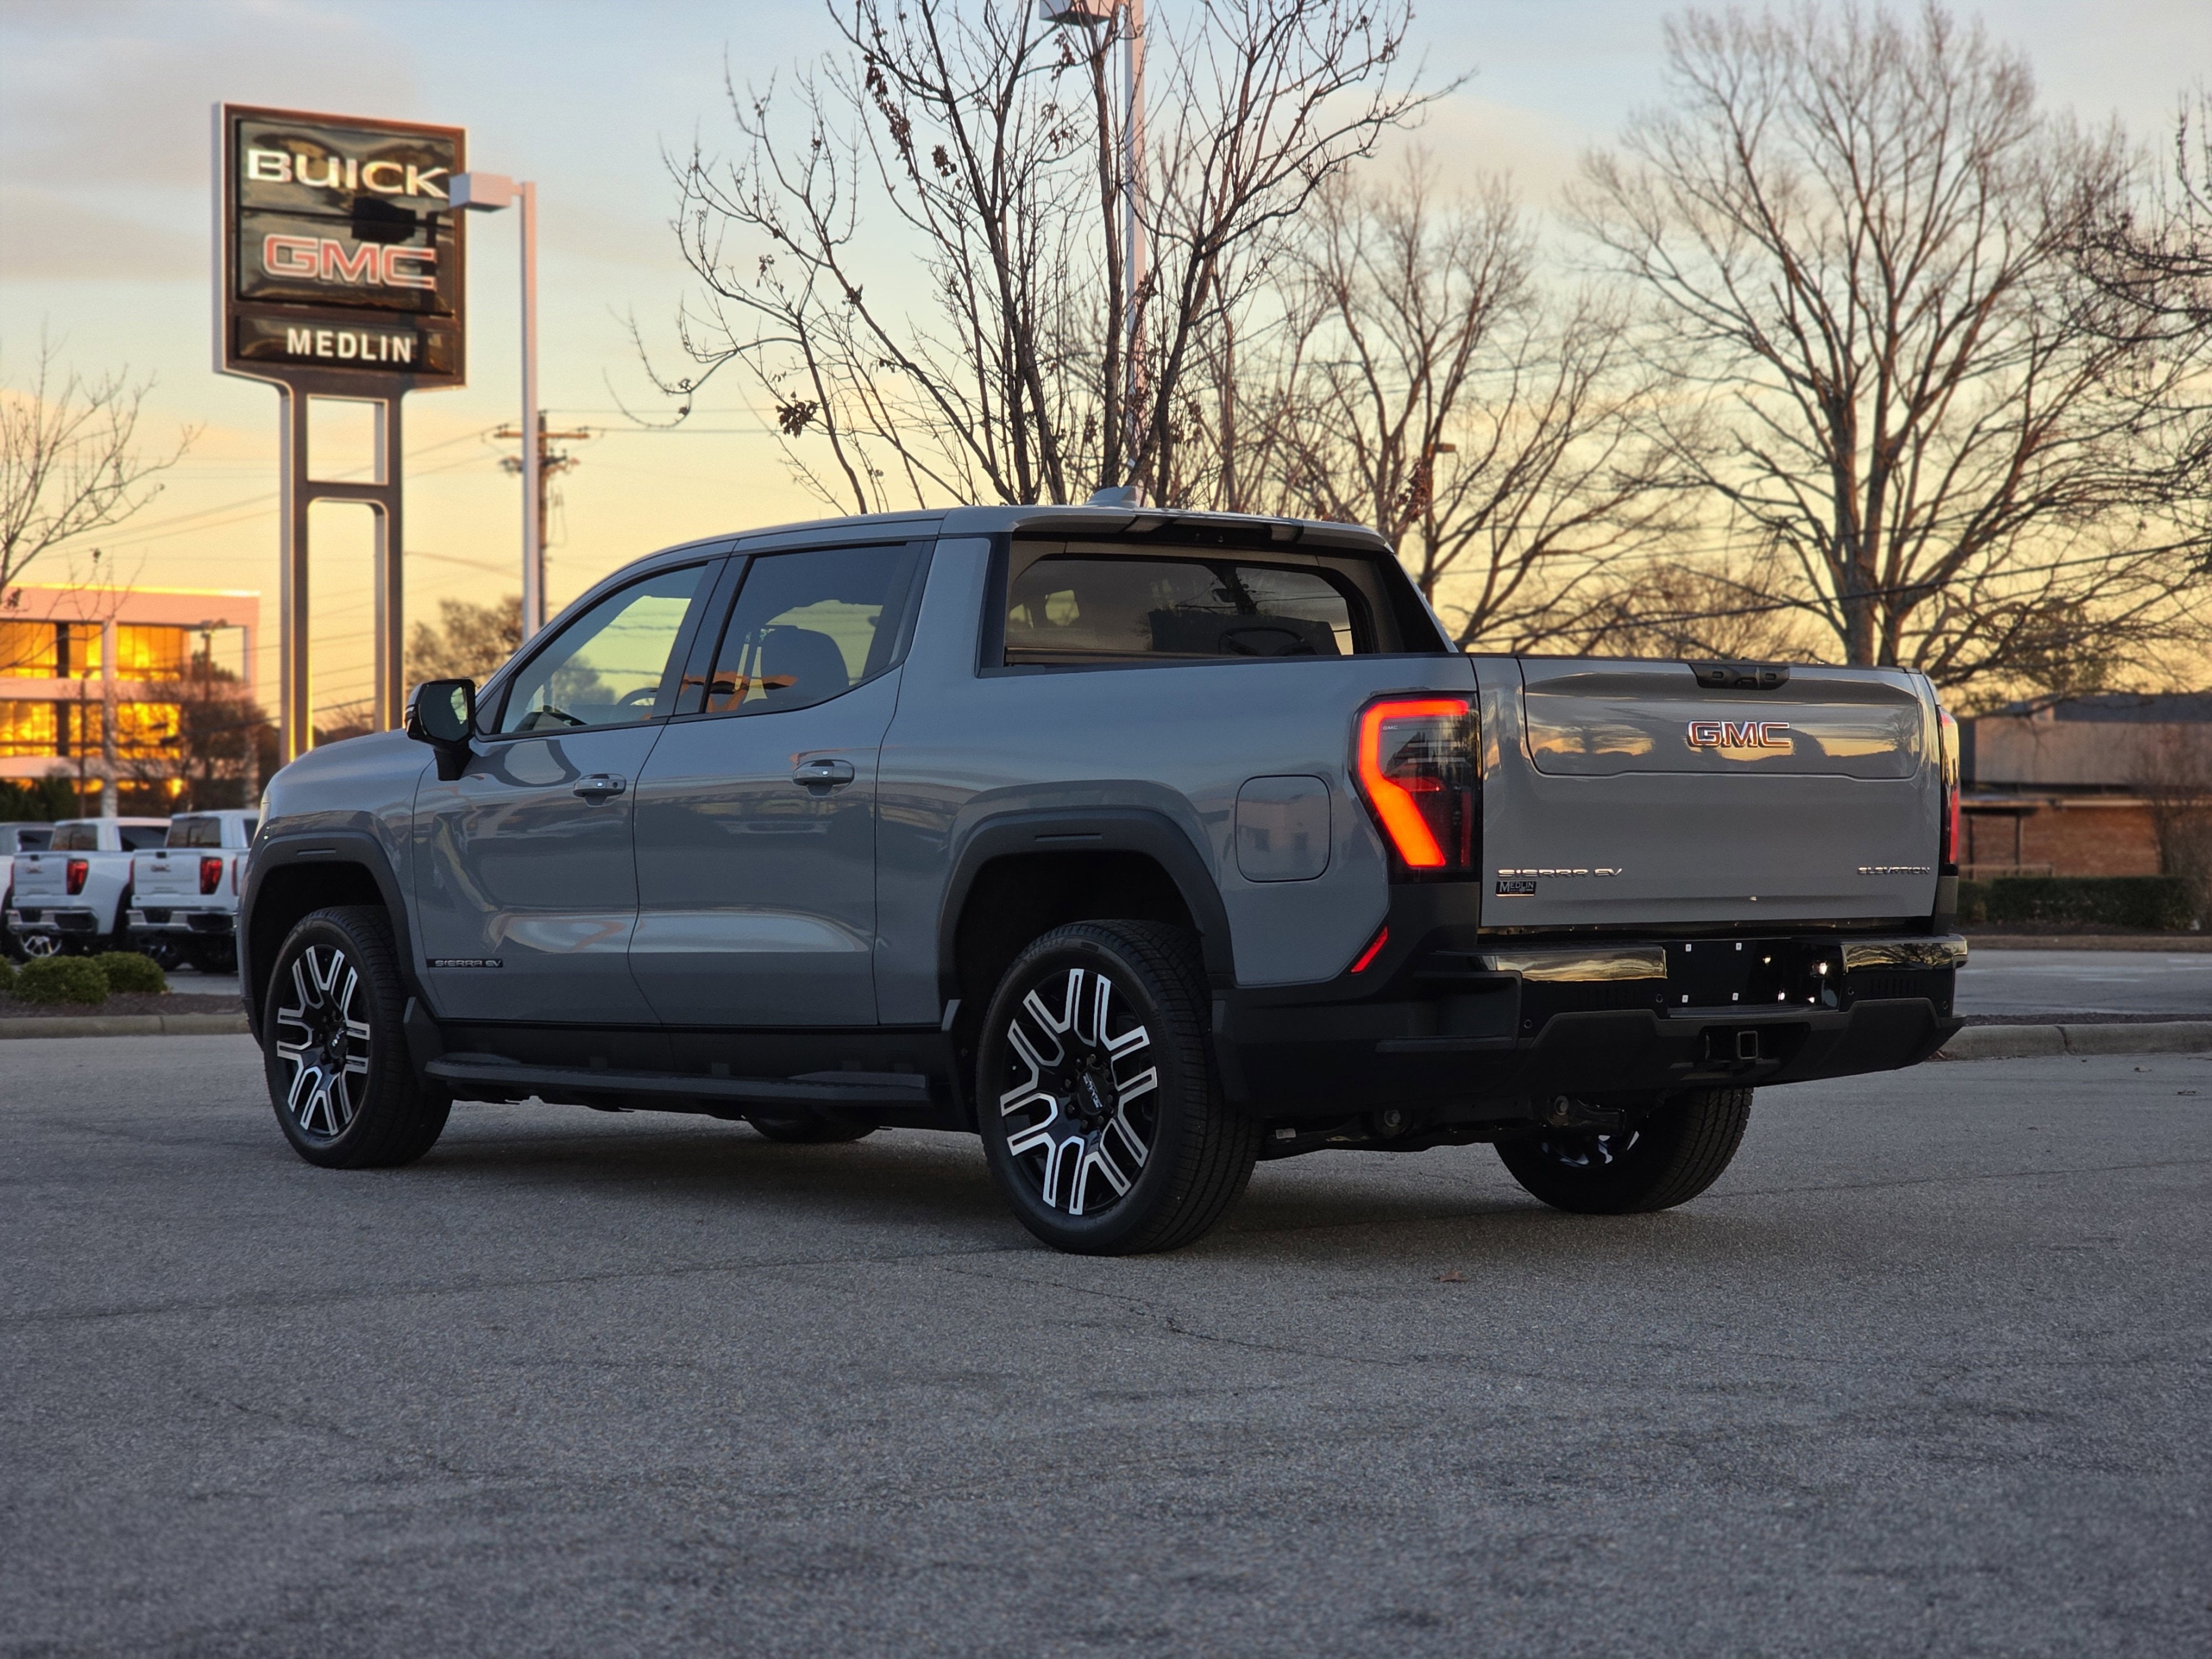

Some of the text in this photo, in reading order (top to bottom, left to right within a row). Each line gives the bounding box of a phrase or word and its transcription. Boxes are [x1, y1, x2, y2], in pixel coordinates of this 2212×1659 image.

[248, 149, 450, 199] BUICK
[263, 233, 437, 291] GMC
[286, 328, 412, 363] MEDLIN
[1687, 720, 1791, 747] GMC
[1498, 868, 1623, 878] SIERRA EV
[1858, 866, 1931, 874] ELEVATION
[1499, 881, 1535, 893] MEDLIN
